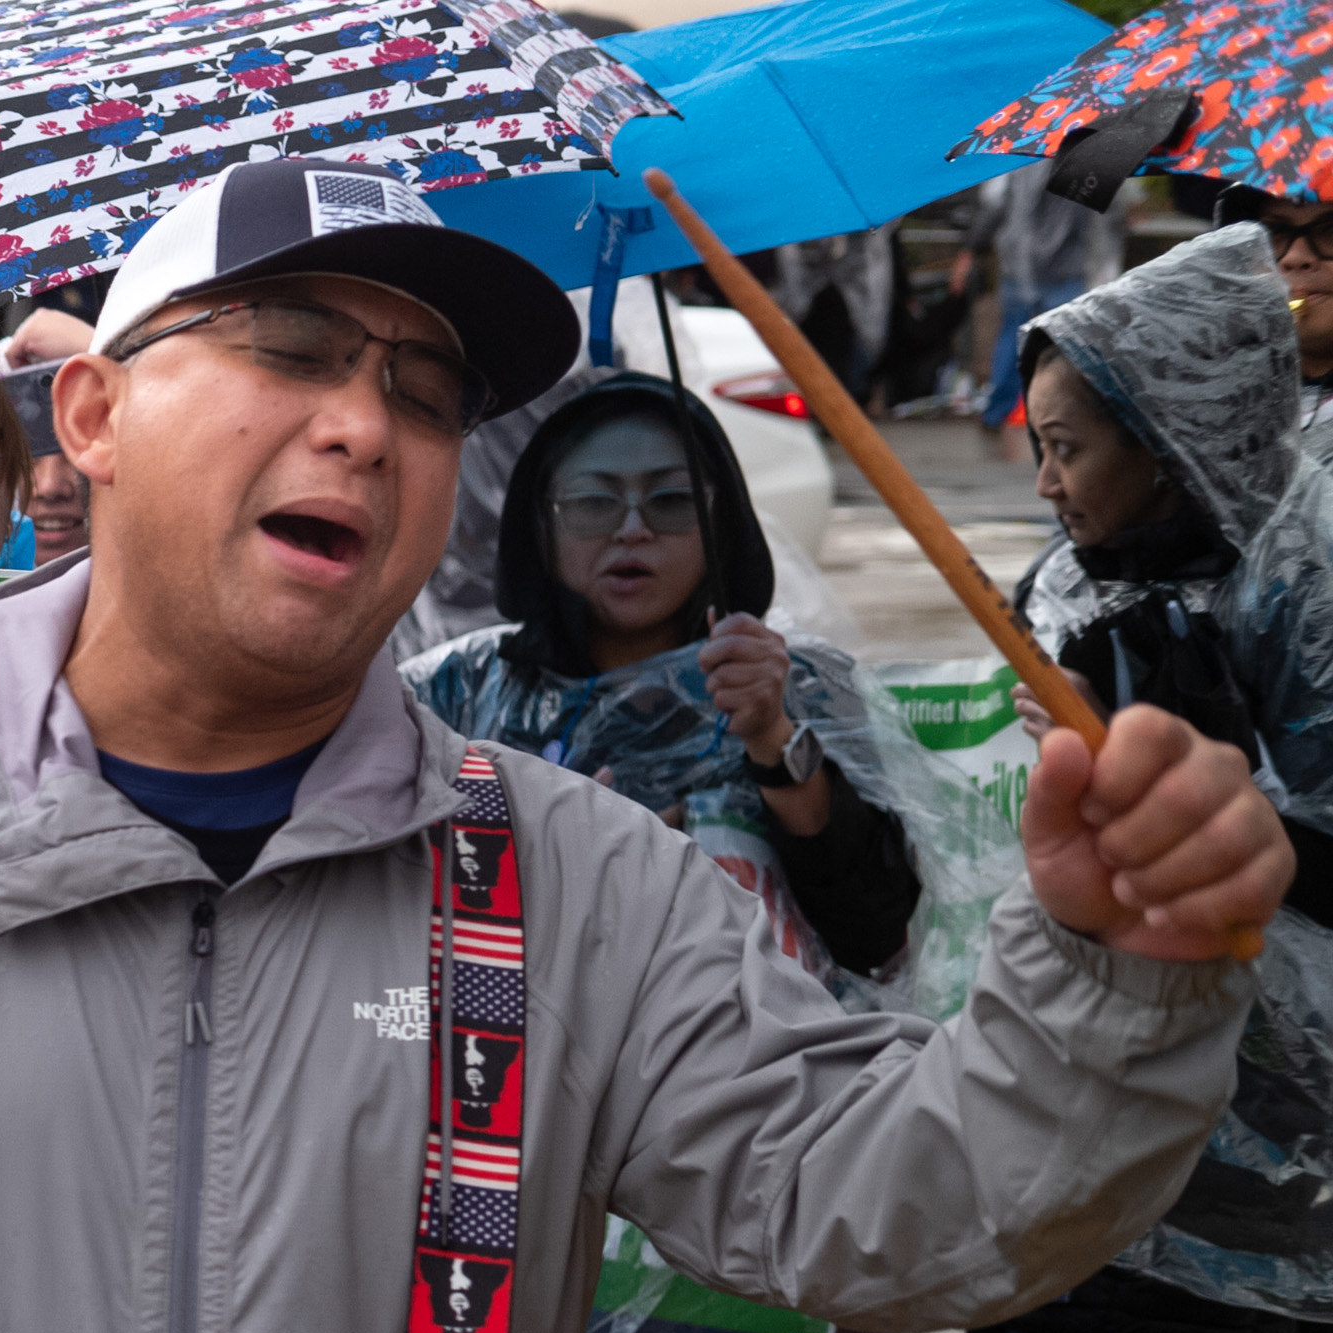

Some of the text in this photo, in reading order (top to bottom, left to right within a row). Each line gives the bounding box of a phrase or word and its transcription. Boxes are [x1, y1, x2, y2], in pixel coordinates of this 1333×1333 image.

[384, 986, 429, 1005] THE
[353, 1002, 430, 1023] NORTH
[377, 1022, 430, 1041] FACE
